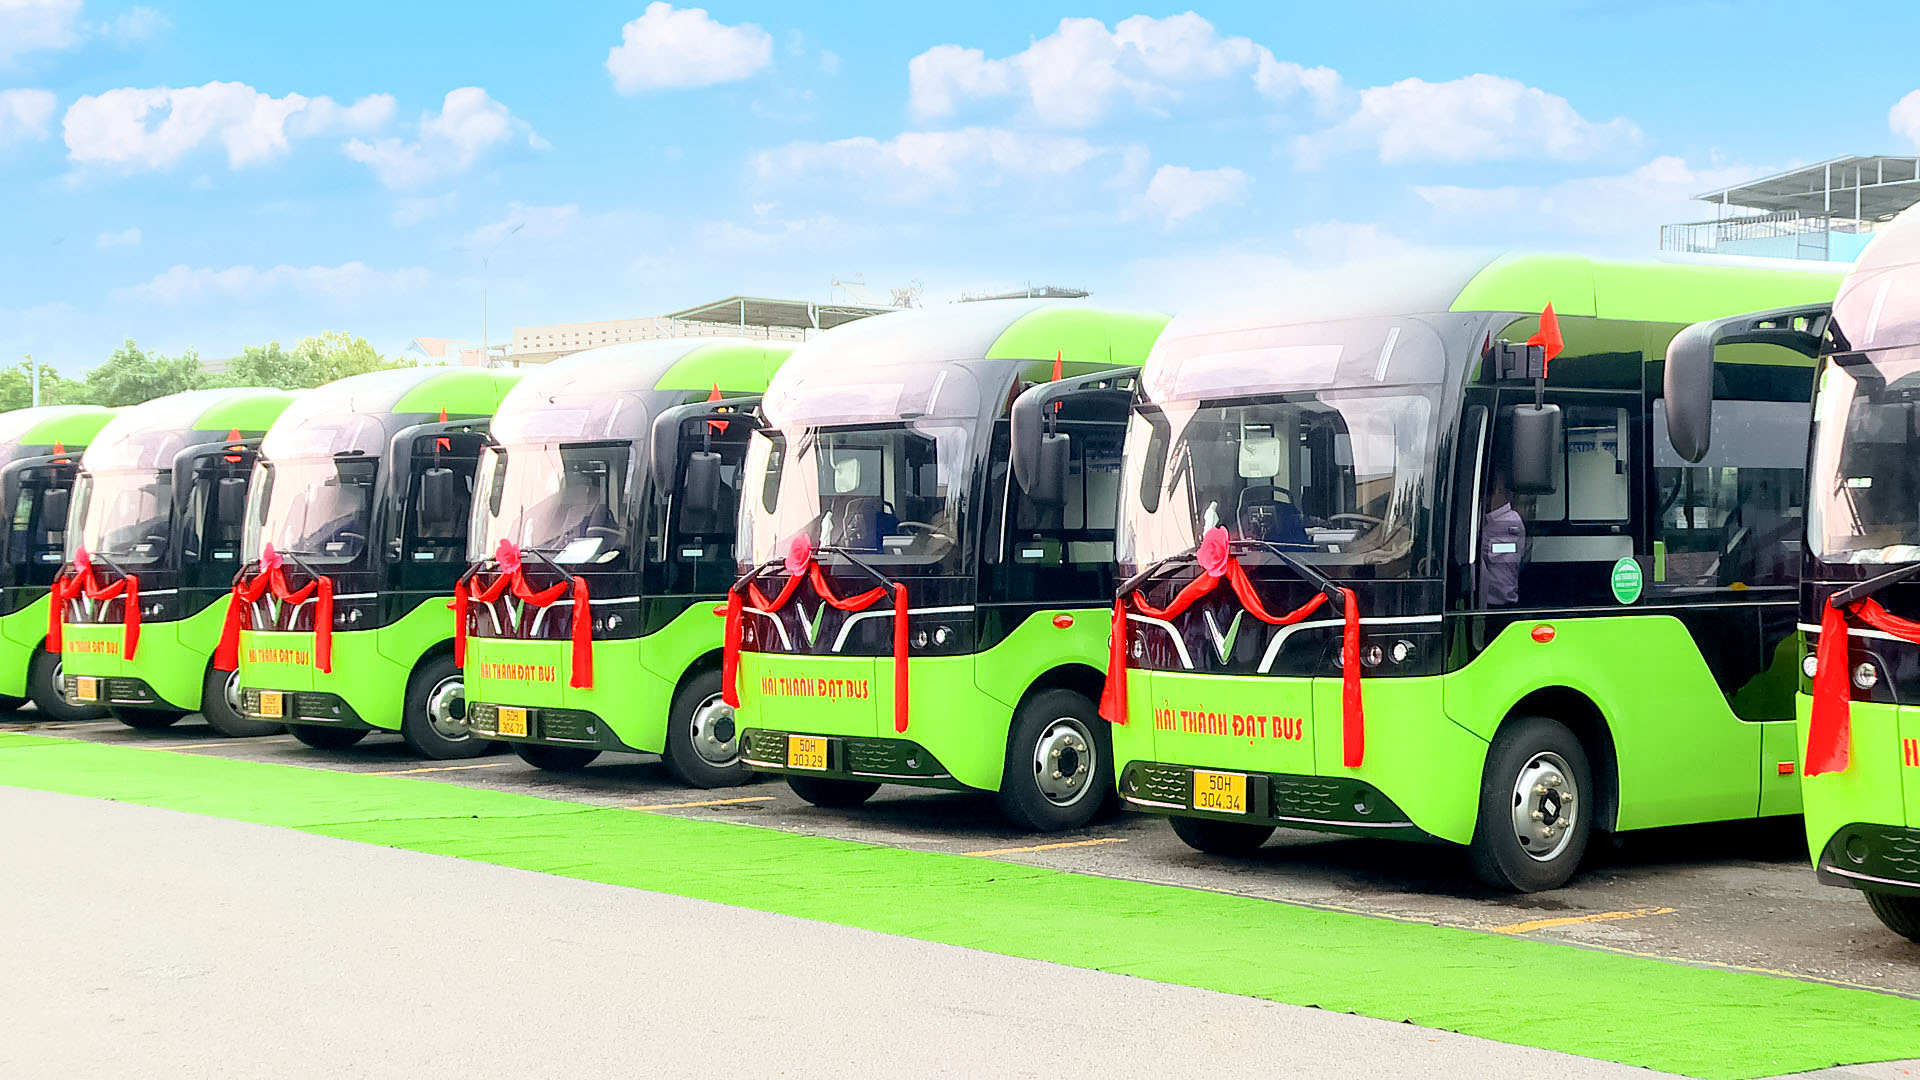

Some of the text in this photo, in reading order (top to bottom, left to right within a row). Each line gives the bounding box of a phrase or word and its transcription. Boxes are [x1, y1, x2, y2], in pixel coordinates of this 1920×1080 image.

[295, 650, 309, 665] BUS
[538, 665, 555, 682] BUS
[818, 679, 843, 703] ĐẠT
[846, 679, 868, 699] BUS
[1155, 699, 1303, 745] HẢI THÀNH ĐẠT BUS
[799, 739, 816, 752] 50H
[793, 753, 823, 768] 303.29
[1209, 775, 1232, 792] 50H
[1200, 792, 1240, 811] 304.34
